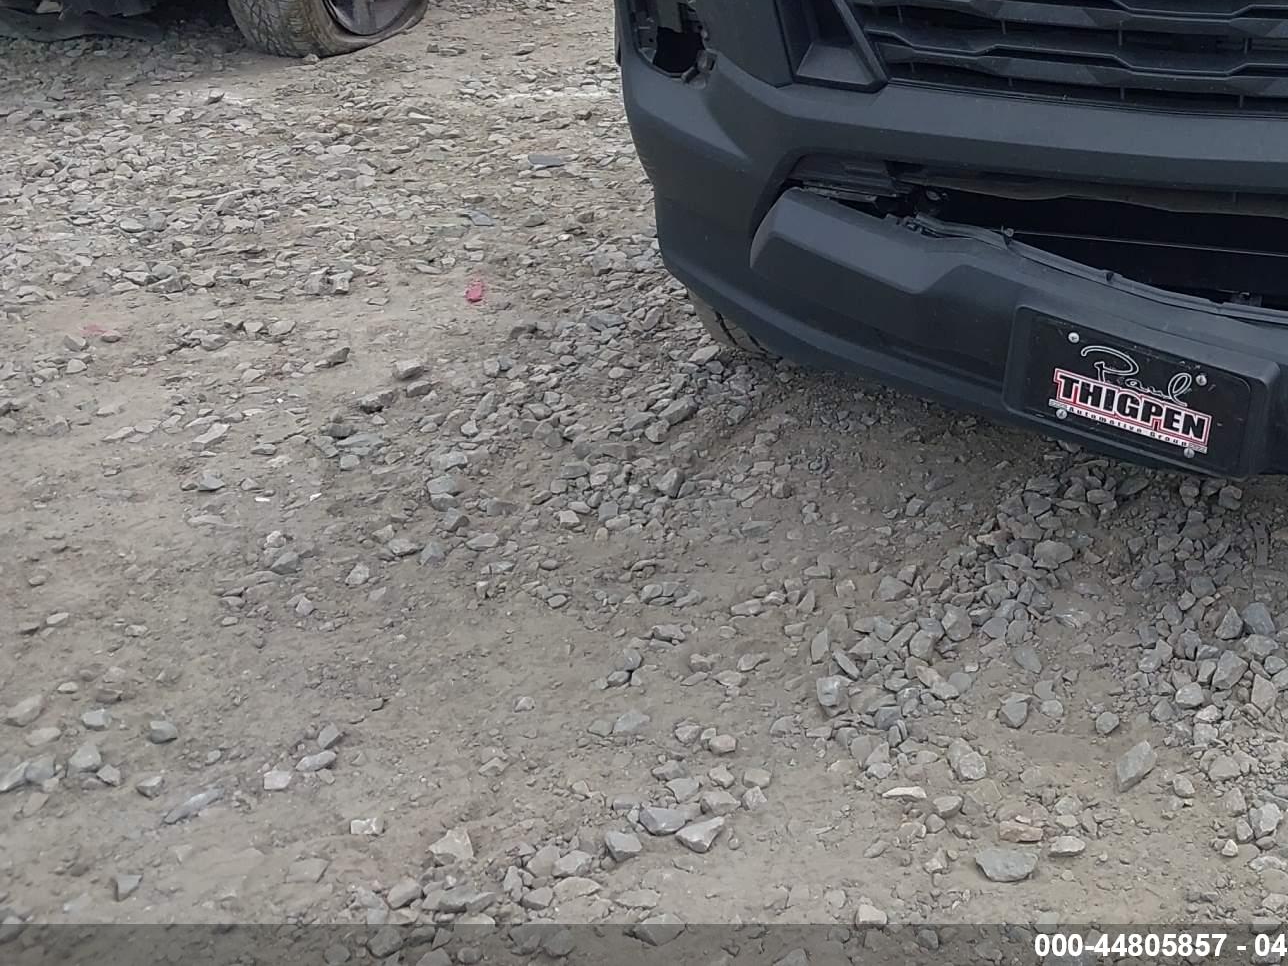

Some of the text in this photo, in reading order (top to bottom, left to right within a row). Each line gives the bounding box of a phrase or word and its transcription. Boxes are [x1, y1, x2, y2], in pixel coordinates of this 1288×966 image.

[1056, 371, 1210, 443] THIGPEN
[1081, 345, 1193, 407] Paul
[1069, 406, 1188, 448] Automotive Group
